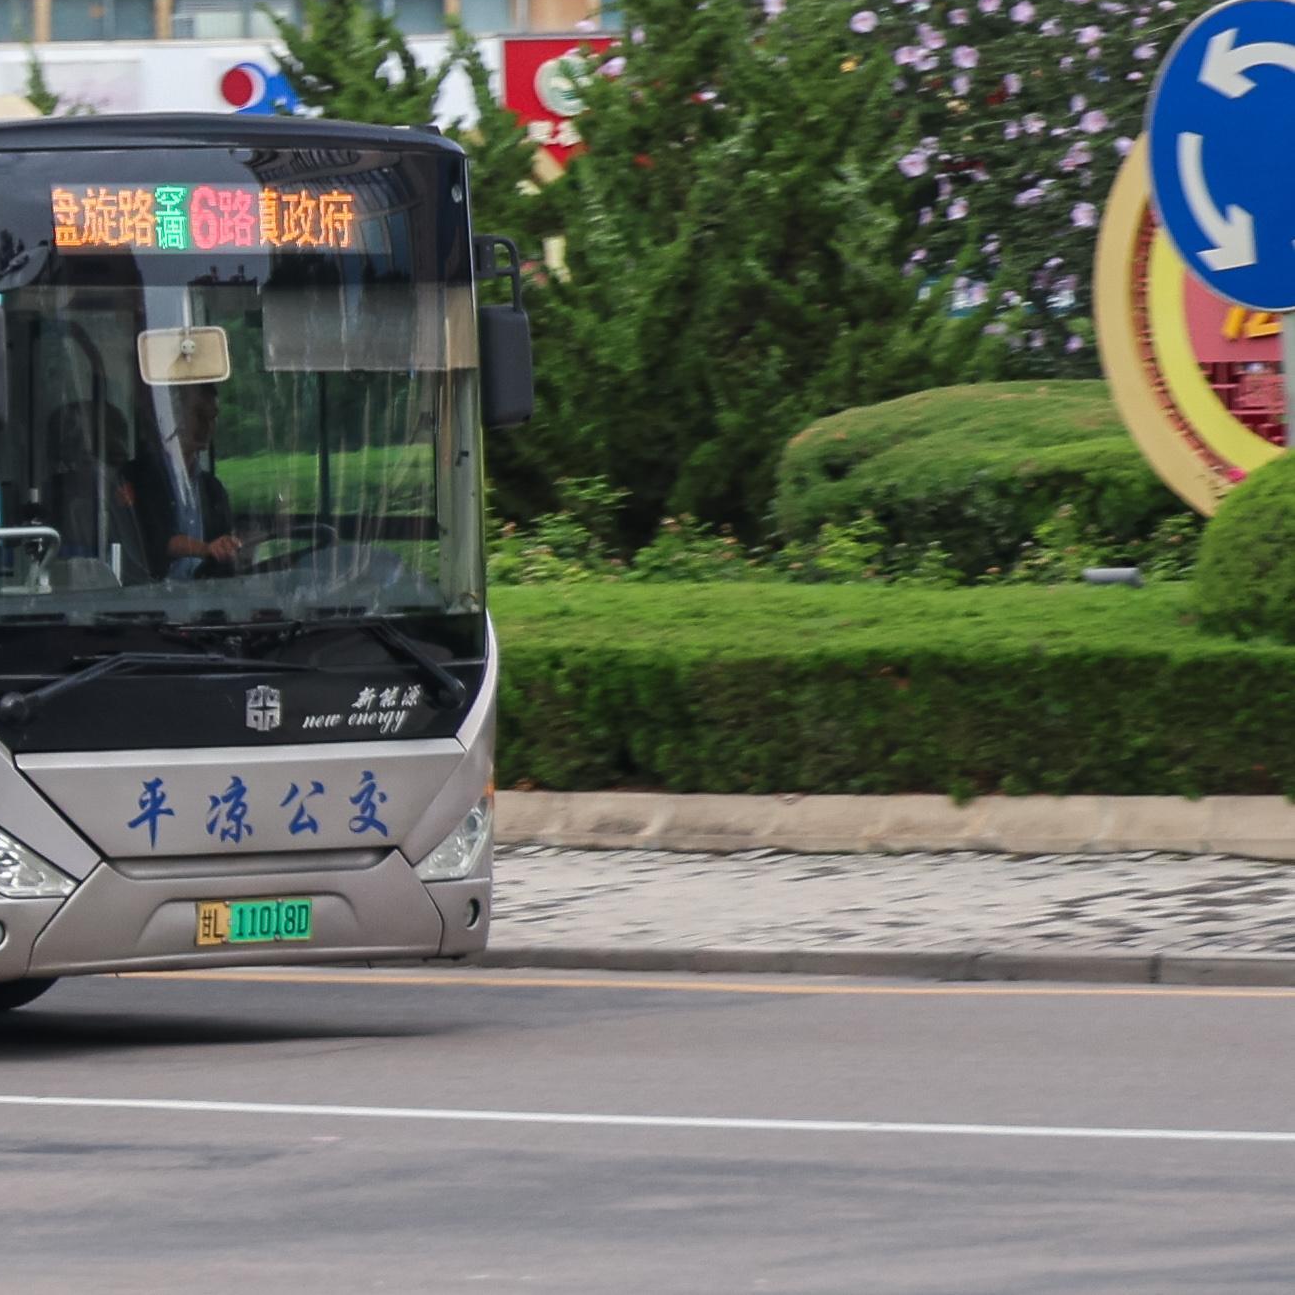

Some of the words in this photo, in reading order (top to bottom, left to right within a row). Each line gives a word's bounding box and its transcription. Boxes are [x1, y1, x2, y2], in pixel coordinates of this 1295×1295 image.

[302, 712, 343, 730] new
[347, 709, 408, 734] energy
[127, 769, 390, 851] 平凉公交
